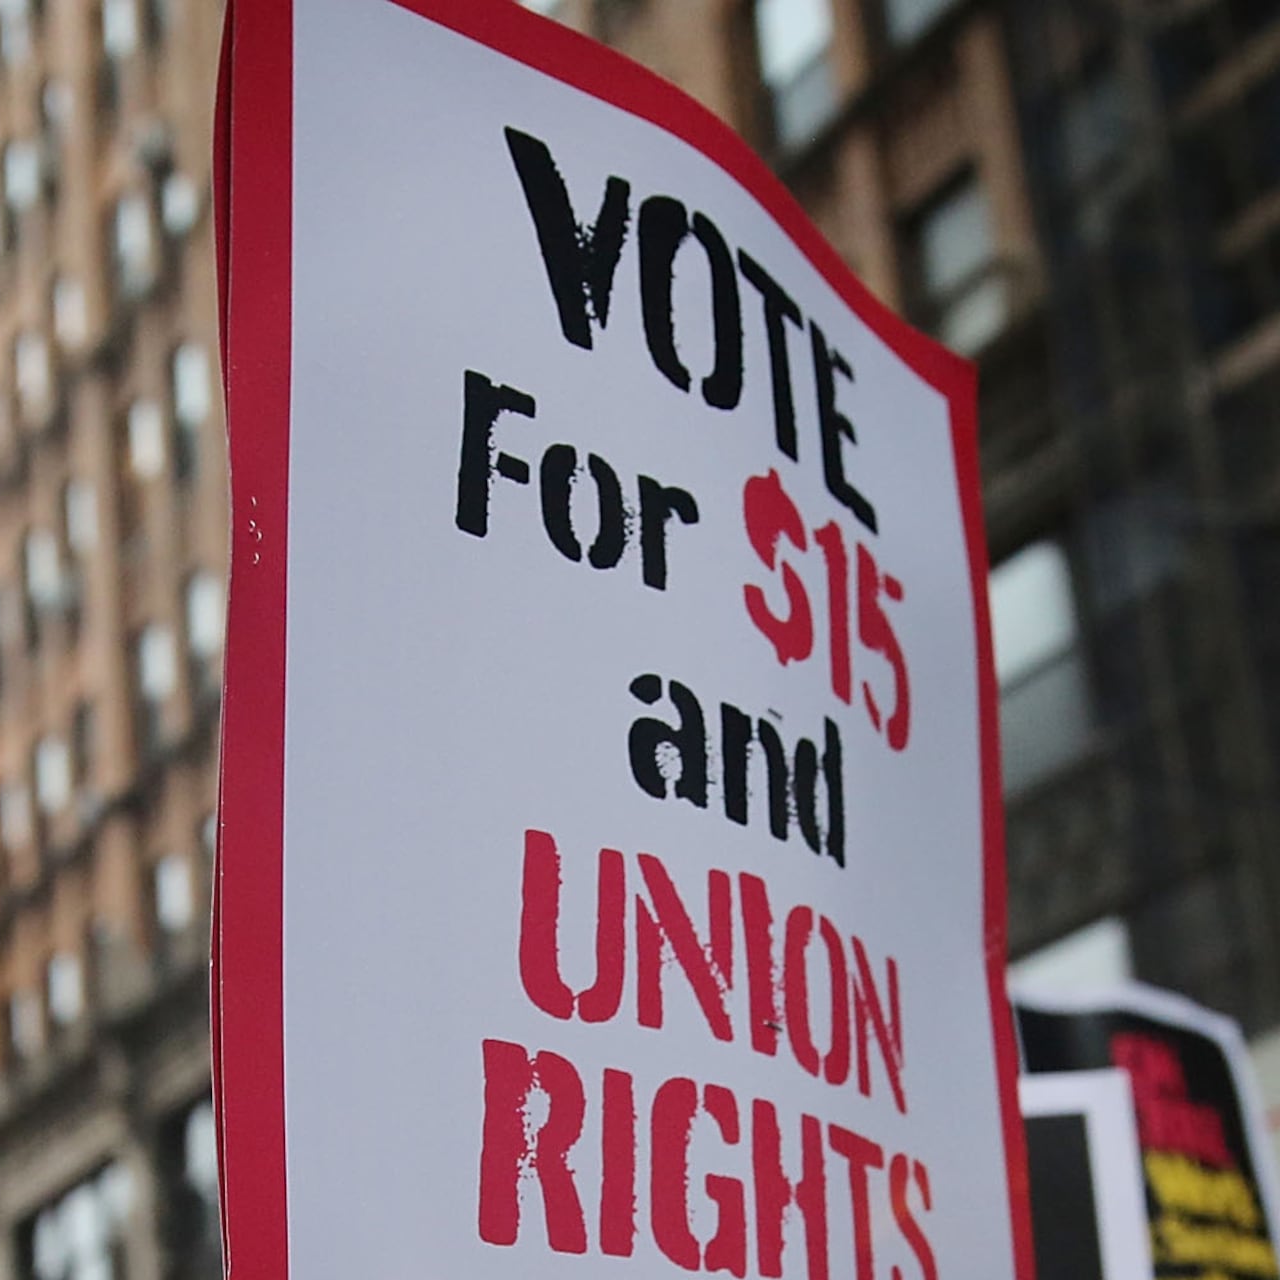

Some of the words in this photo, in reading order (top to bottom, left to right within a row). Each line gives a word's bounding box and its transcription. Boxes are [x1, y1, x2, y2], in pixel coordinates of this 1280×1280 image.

[504, 126, 878, 536] VOTE
[456, 369, 699, 591] For
[742, 467, 910, 752] $15
[628, 673, 846, 869] and
[519, 829, 908, 1115] UNION
